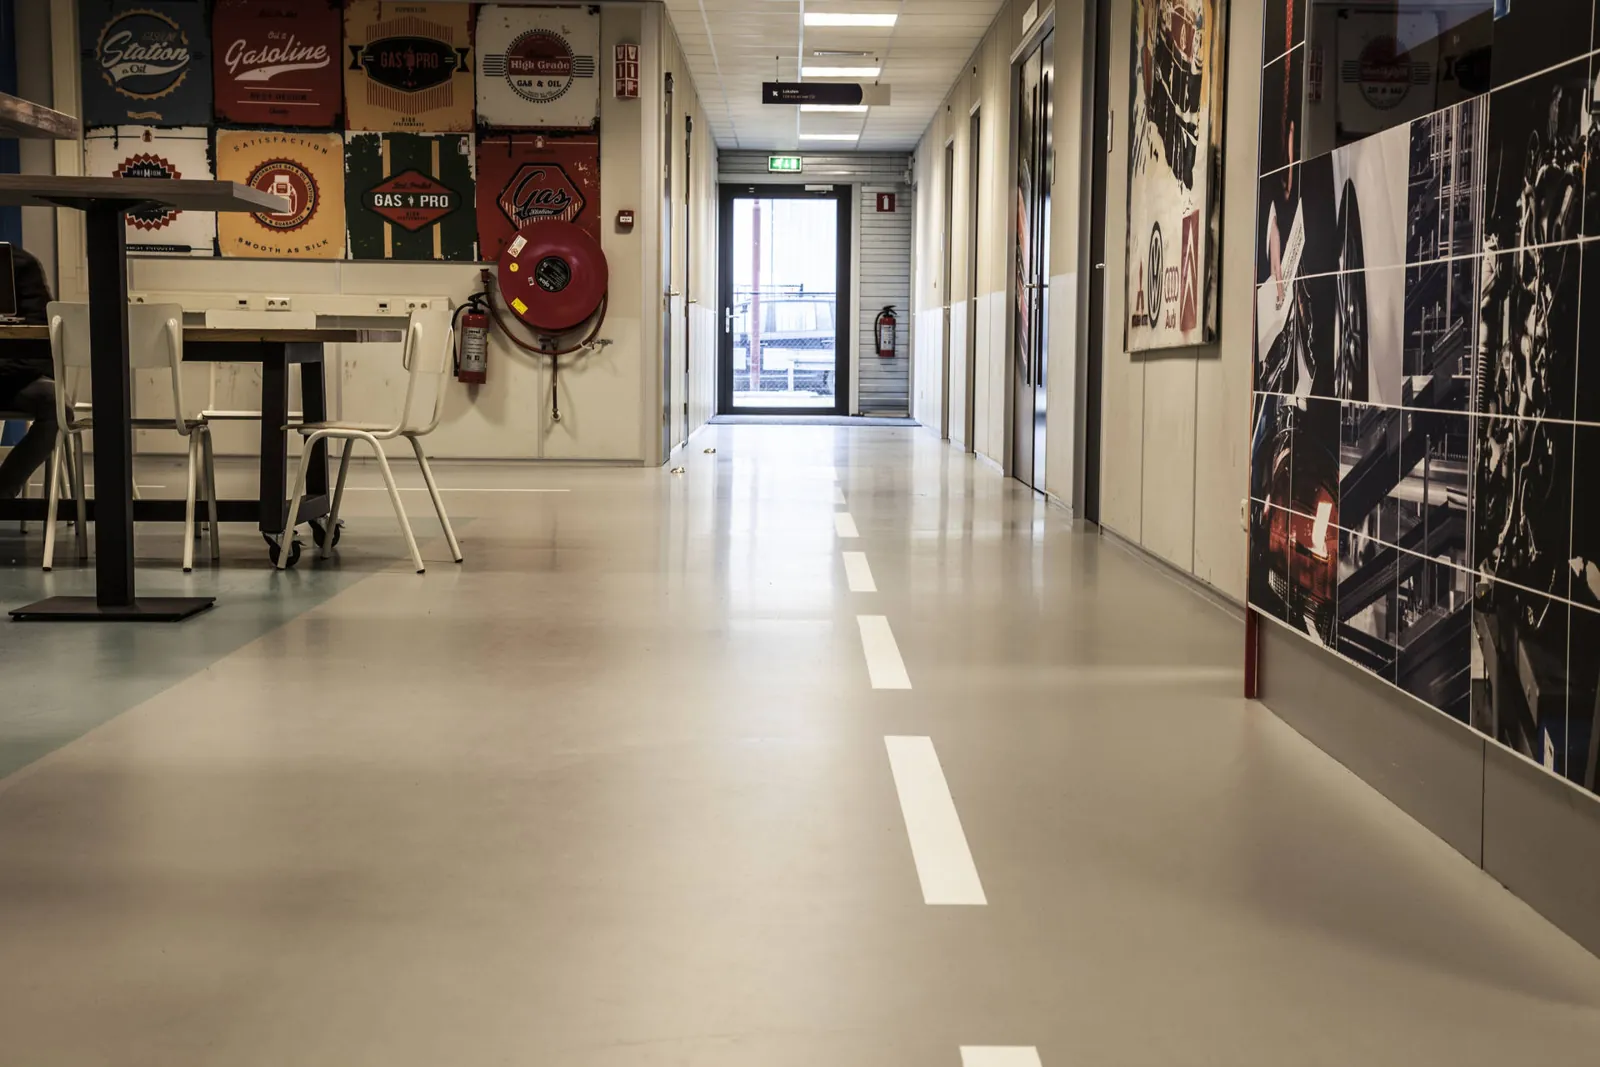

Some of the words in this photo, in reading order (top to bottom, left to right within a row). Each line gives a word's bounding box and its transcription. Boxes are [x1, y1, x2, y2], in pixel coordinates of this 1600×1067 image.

[101, 30, 190, 68] Station
[224, 34, 329, 74] Gasoline
[129, 64, 147, 74] Oil
[380, 51, 402, 68] GAS
[416, 52, 438, 69] PRO
[510, 60, 535, 70] High
[537, 60, 570, 70] Grade
[547, 80, 562, 88] OIL
[233, 136, 328, 154] SATISFACTION
[251, 164, 282, 187] PERFORMANCE
[299, 172, 307, 181] OIL
[306, 181, 314, 203] STATION
[513, 169, 570, 215] Gas
[374, 194, 402, 207] GAS
[420, 195, 449, 208] PRO
[238, 237, 281, 253] SMOOTH
[305, 239, 329, 251] SILK
